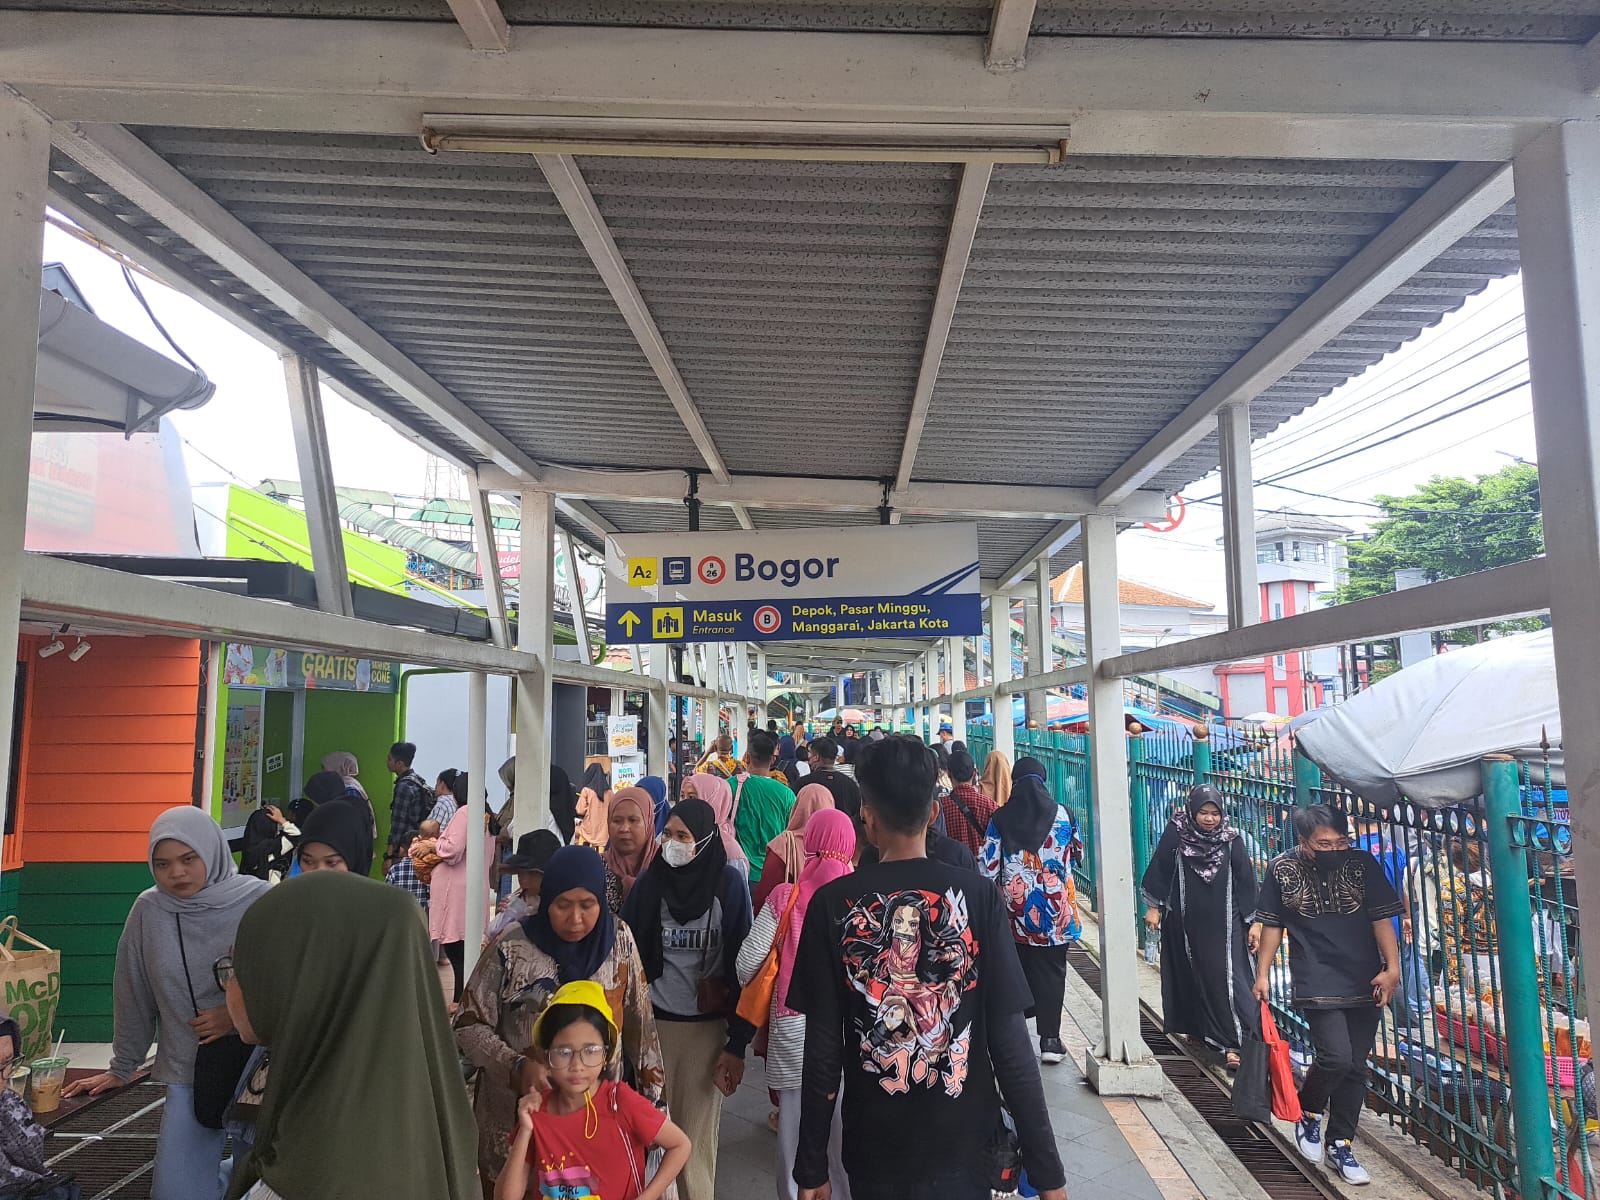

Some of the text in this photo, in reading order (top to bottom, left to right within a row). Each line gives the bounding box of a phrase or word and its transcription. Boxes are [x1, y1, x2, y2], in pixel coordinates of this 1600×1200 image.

[633, 565, 652, 579] A2
[706, 570, 718, 578] 26
[735, 553, 840, 587] Bogor
[693, 609, 742, 623] Masuk
[792, 602, 931, 618] Depok, Pasar Minggu,
[763, 614, 771, 624] B
[792, 617, 949, 634] Manggarai, Jakarta Kota
[692, 625, 735, 635] Entrance
[302, 653, 357, 681] GRATIS
[371, 670, 390, 683] CONE
[558, 1184, 579, 1195] GIRL
